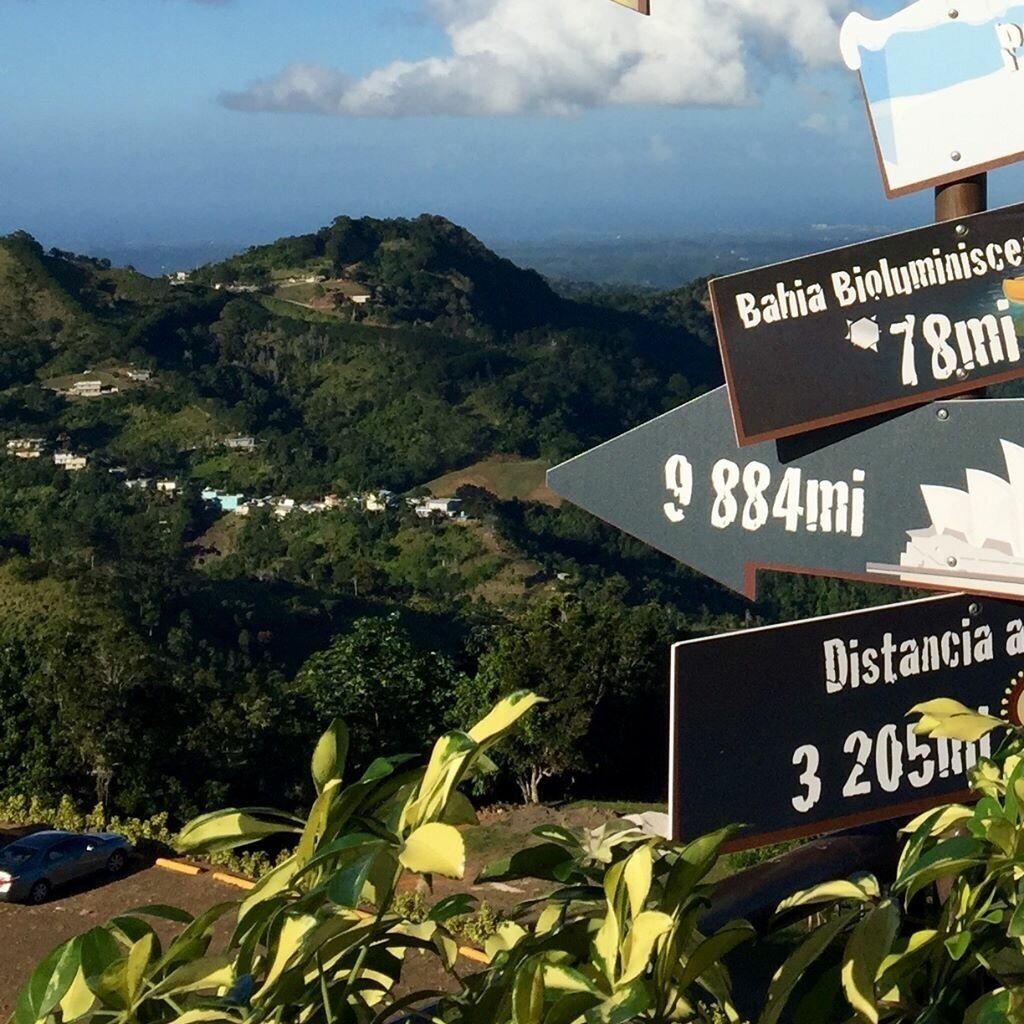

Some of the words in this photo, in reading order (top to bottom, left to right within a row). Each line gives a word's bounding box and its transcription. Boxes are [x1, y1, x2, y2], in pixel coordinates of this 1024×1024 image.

[735, 278, 828, 329] Bahia
[889, 298, 1021, 387] 78mi
[663, 453, 693, 522] 9
[711, 458, 866, 538] 884mi
[823, 617, 994, 694] Distancia
[791, 744, 822, 813] 3
